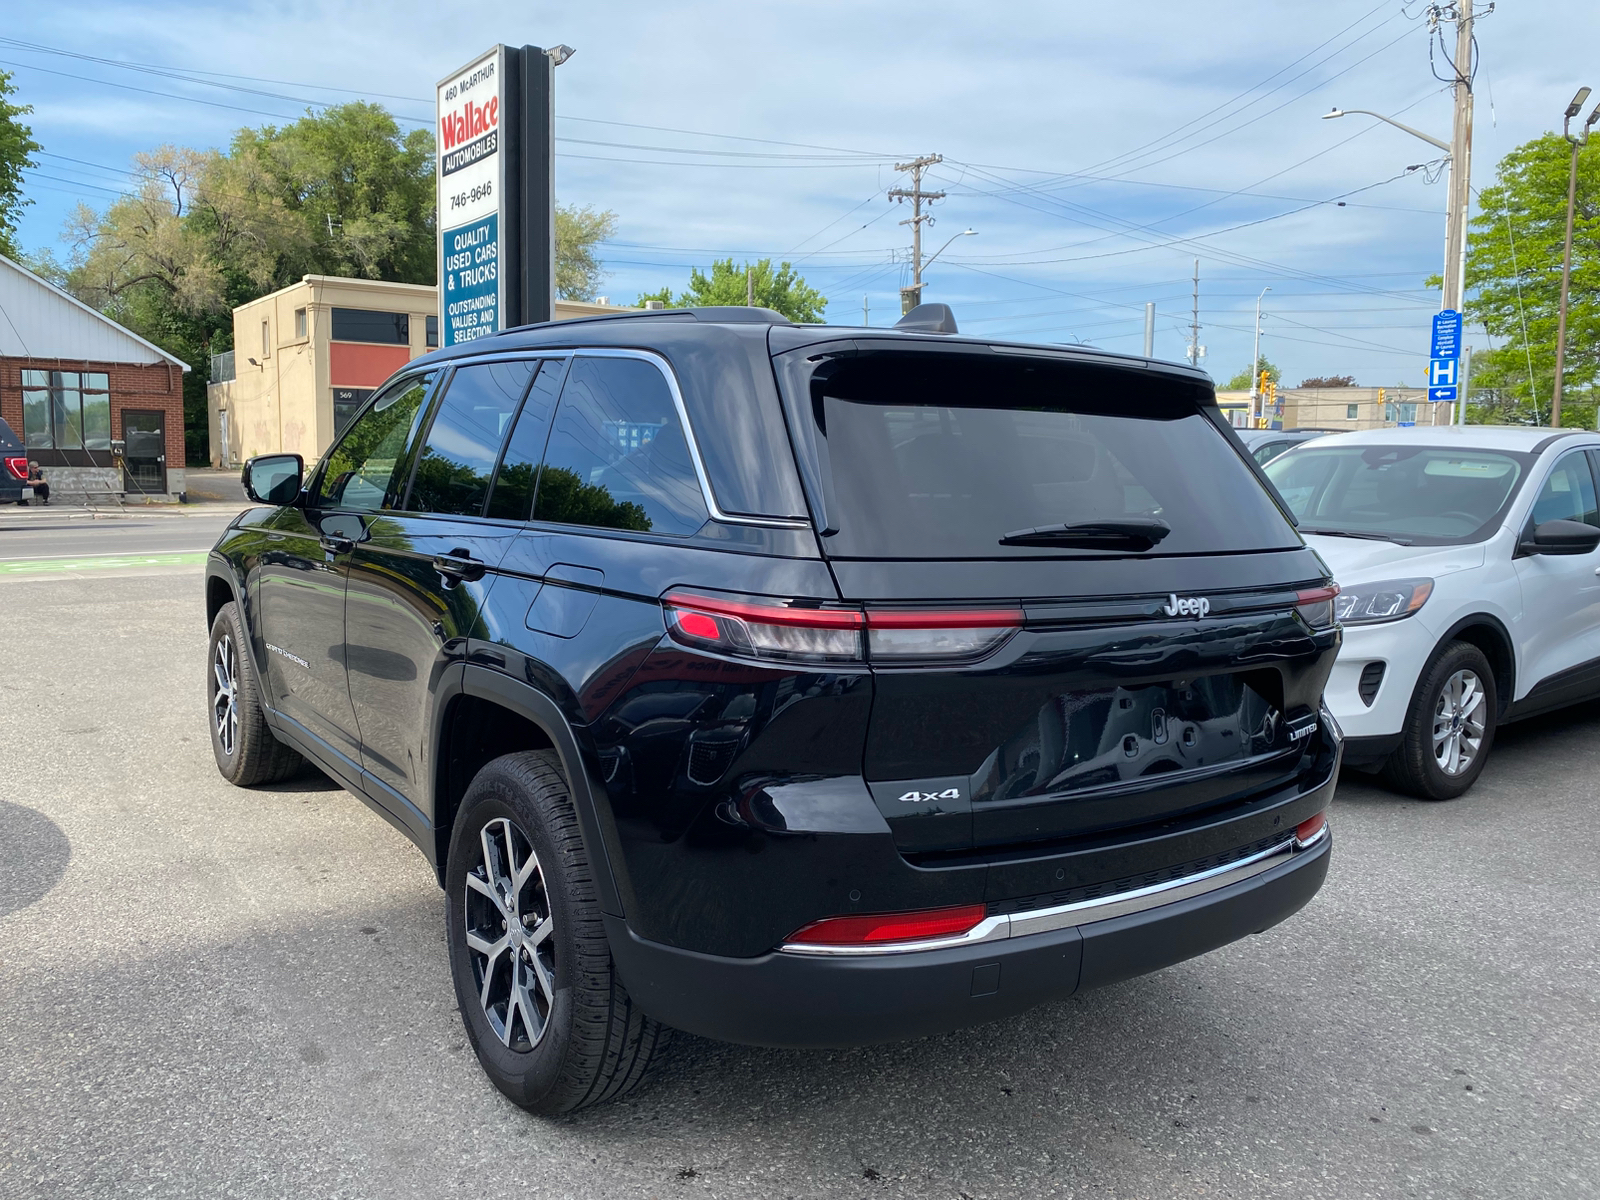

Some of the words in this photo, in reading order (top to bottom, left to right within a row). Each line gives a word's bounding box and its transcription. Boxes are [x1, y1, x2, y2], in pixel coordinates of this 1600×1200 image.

[445, 86, 457, 101] 460
[460, 63, 494, 94] McARTHUR
[441, 95, 498, 150] Wallace
[445, 133, 496, 172] AUTOMOBILES
[450, 180, 492, 210] 746-9646
[454, 225, 490, 250] QUALITY
[446, 251, 471, 271] USED
[475, 242, 497, 265] CARS
[448, 274, 455, 290] &
[460, 262, 496, 288] TRUCKS
[448, 293, 496, 316] OUTSTANDING
[451, 313, 477, 329] VALUES
[480, 309, 494, 325] AND
[454, 325, 492, 343] SELECTION
[1433, 360, 1454, 385] H
[339, 391, 352, 399] 569
[1164, 593, 1210, 618] Jeep
[1288, 723, 1318, 742] LIMITED
[898, 788, 960, 802] 4x4
